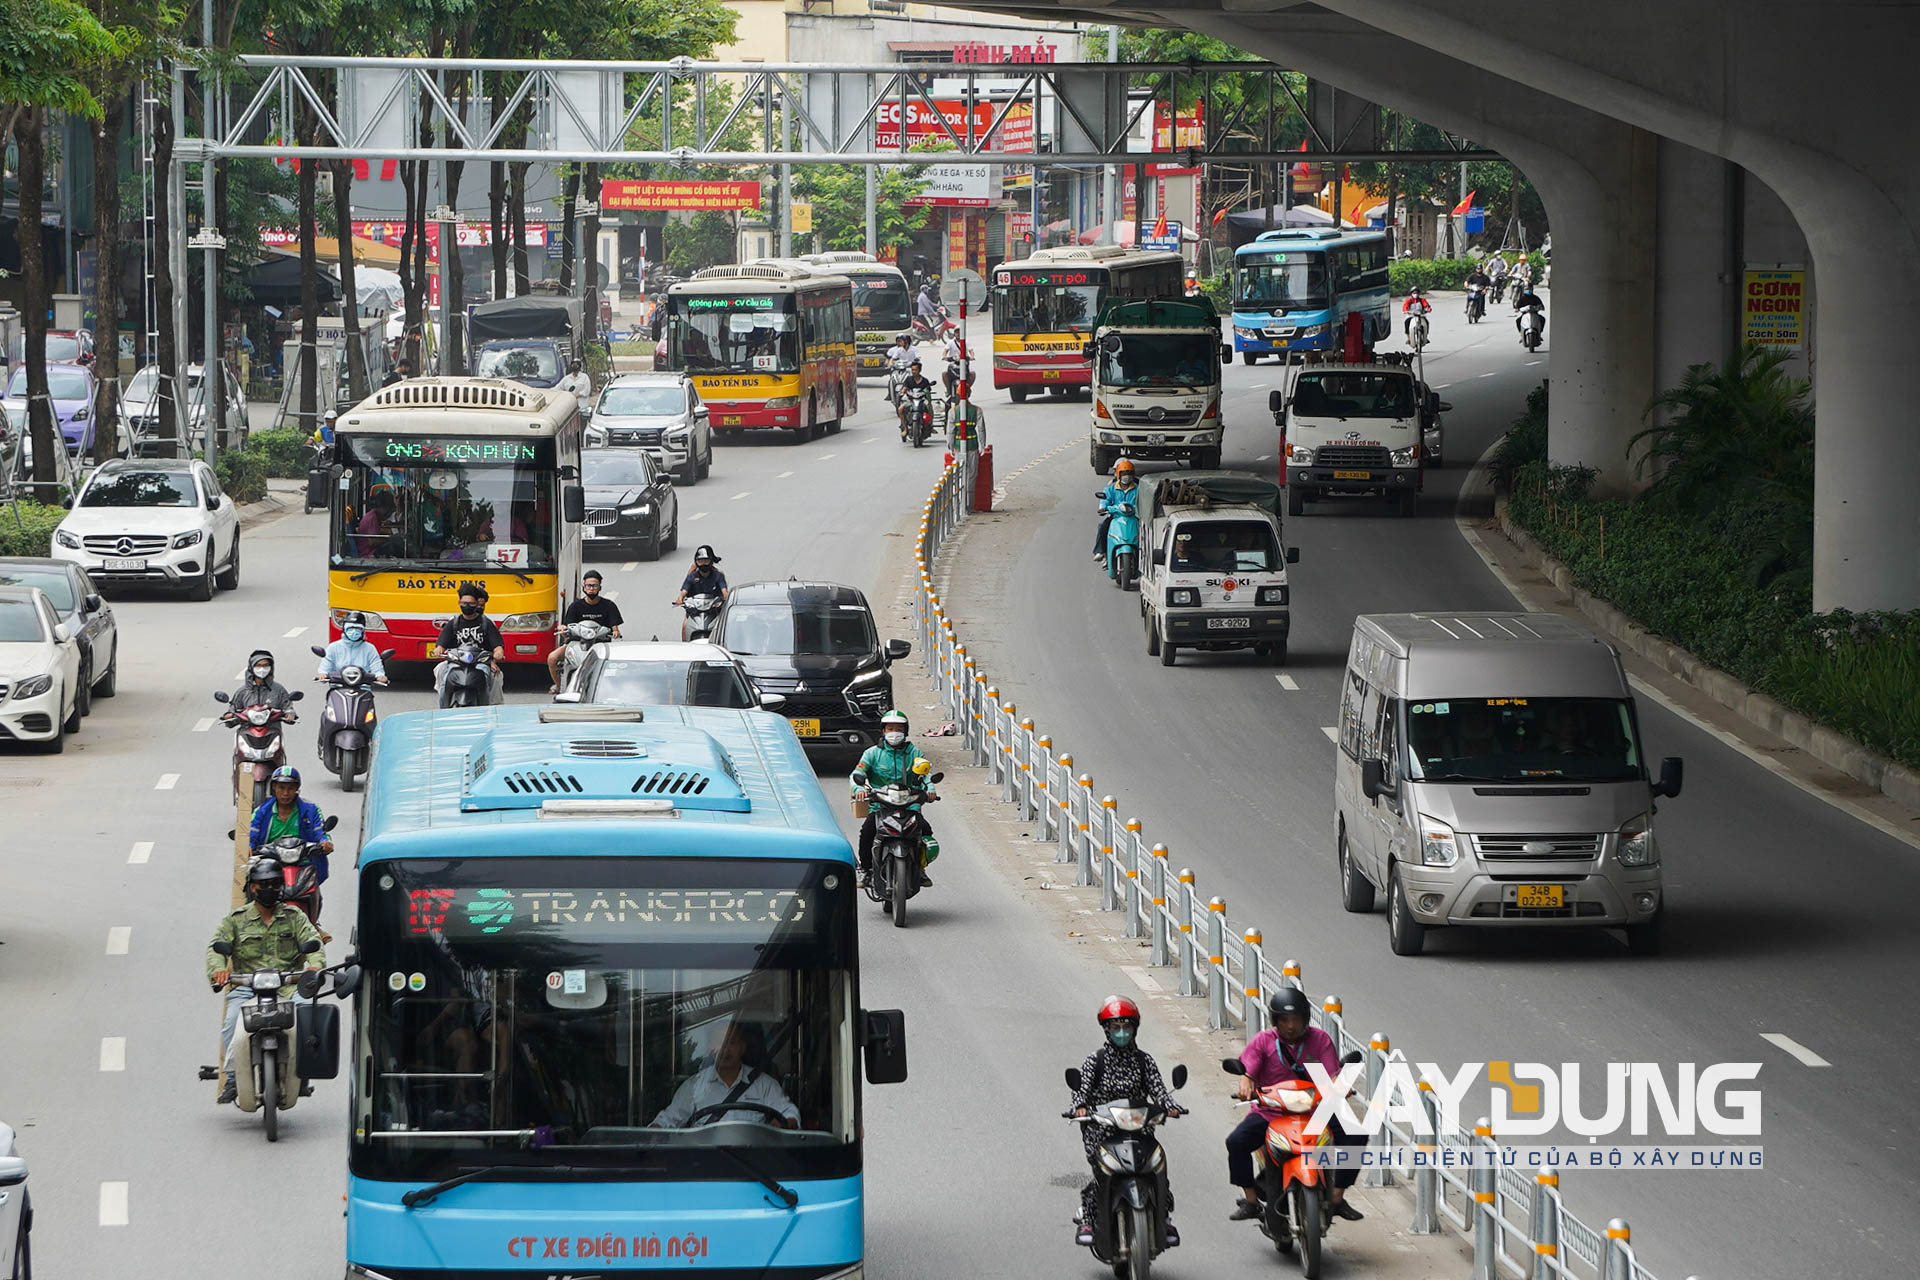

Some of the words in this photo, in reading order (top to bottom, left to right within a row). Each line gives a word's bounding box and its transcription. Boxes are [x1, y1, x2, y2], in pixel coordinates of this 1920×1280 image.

[953, 40, 1004, 64] KÍNH
[1011, 36, 1058, 64] MẮT
[939, 169, 948, 177] XE
[950, 169, 960, 177] GA
[965, 169, 974, 177] XE
[1013, 274, 1035, 285] LOA
[1748, 281, 1801, 296] CƠM
[1747, 298, 1800, 312] NGON
[1776, 330, 1798, 338] 50m
[1065, 342, 1080, 351] BUS
[758, 357, 771, 367] 61
[742, 379, 759, 387] BUS
[497, 548, 521, 564] 57
[794, 720, 810, 728] 29H
[1530, 886, 1550, 896] 34B
[1522, 896, 1558, 906] 022.29
[549, 975, 561, 986] 07
[507, 1236, 538, 1258] CT
[543, 1236, 570, 1258] XE
[576, 1231, 627, 1265] ĐIỆN
[632, 1231, 661, 1258] HÀ
[666, 1231, 708, 1265] NỘI
